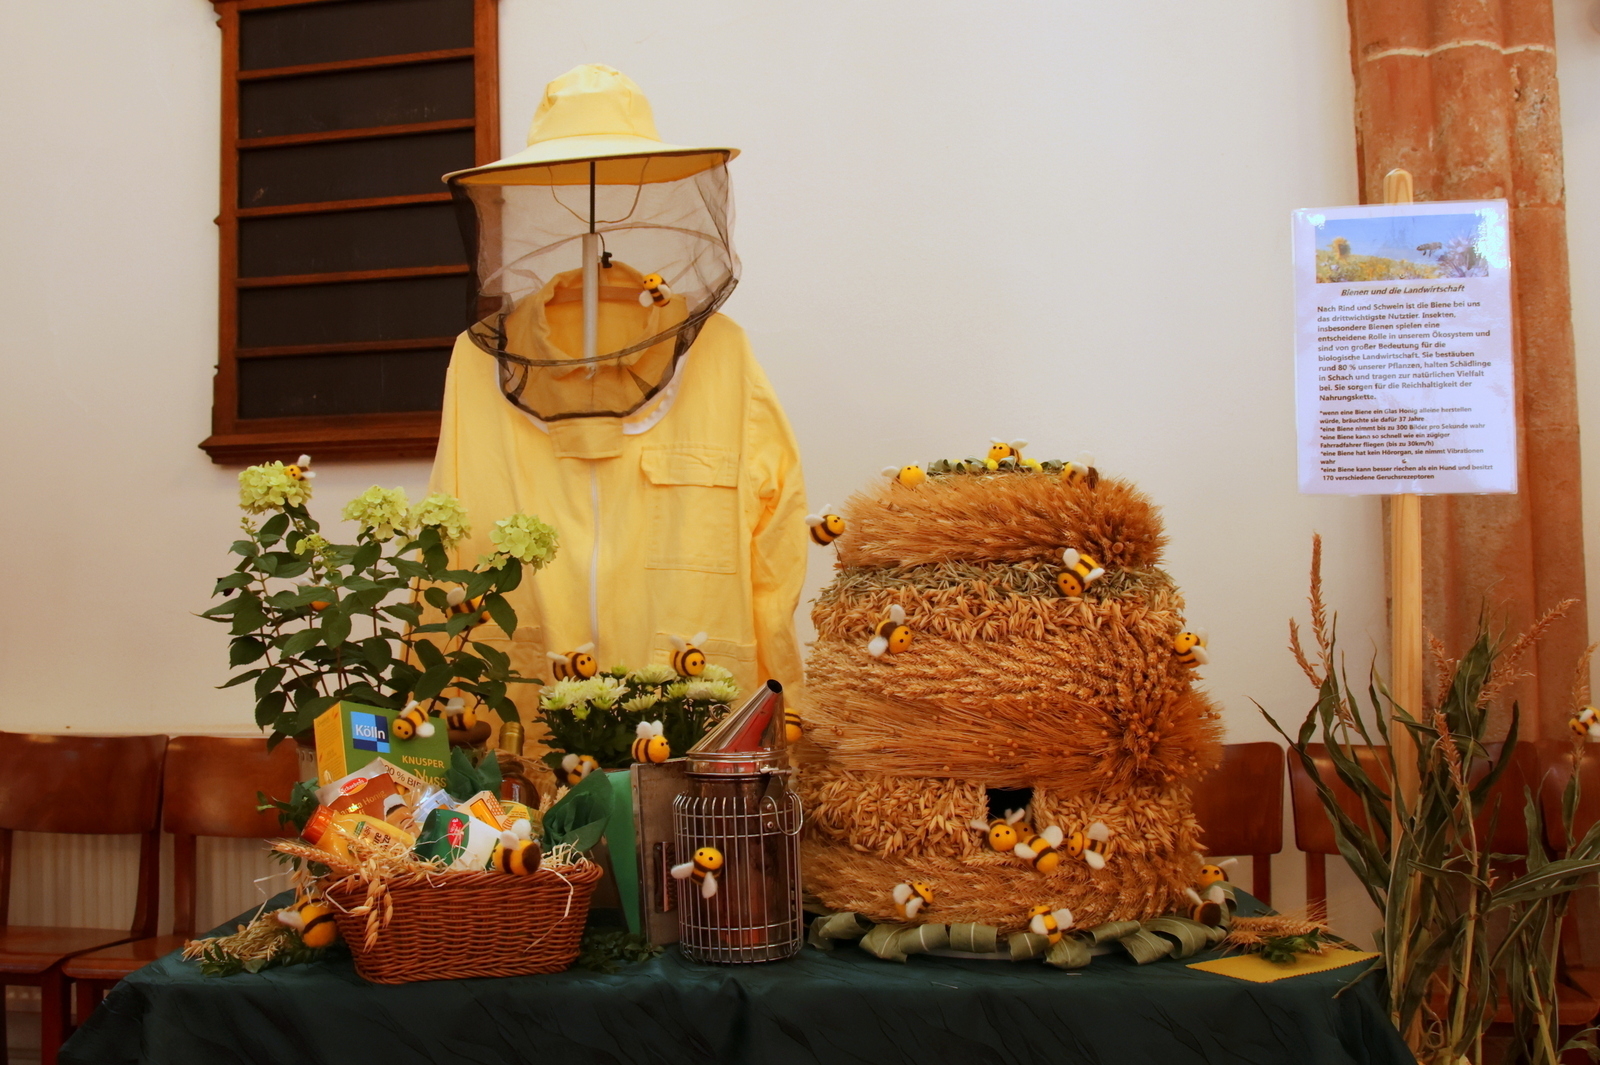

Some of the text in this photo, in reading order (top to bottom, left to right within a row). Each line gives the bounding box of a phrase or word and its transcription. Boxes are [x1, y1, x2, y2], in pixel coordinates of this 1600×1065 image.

[1404, 285, 1464, 294] Landwirtschaft
[1432, 330, 1473, 339] Ökosystem
[1319, 394, 1376, 402] Nahrungskette.
[355, 724, 386, 740] Kölln
[402, 755, 445, 769] KNUSPER
[362, 790, 386, 806] Honig
